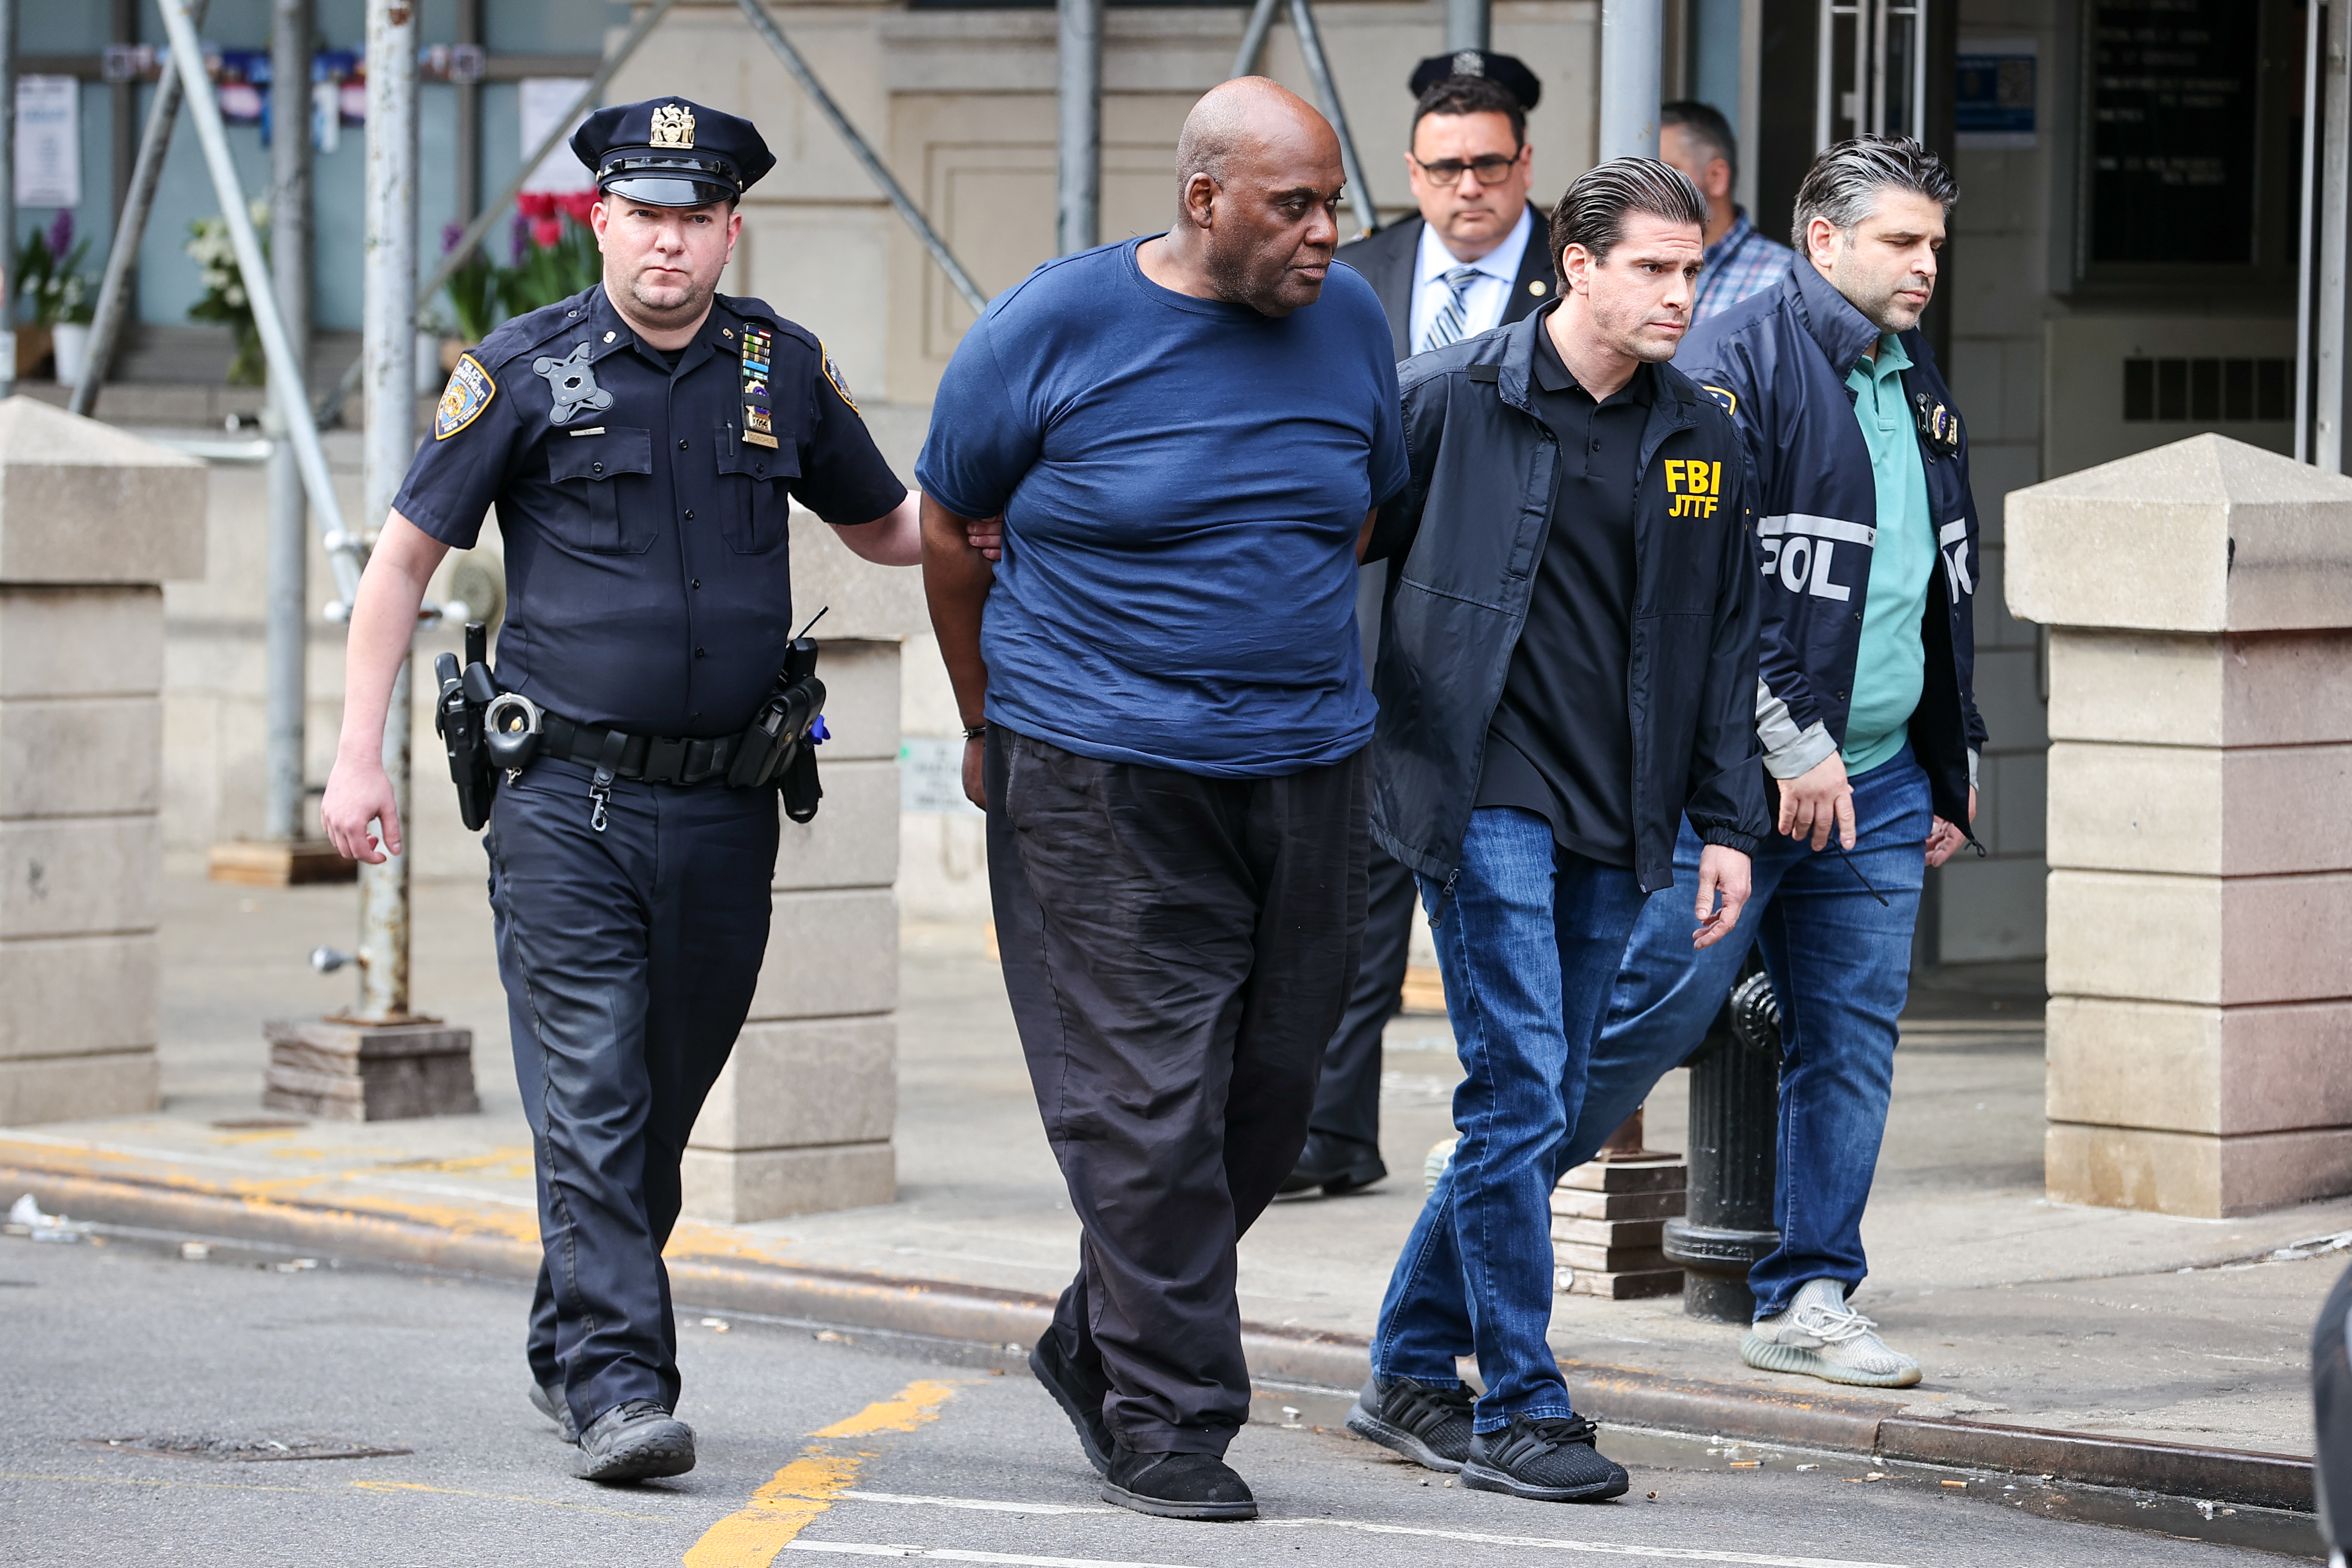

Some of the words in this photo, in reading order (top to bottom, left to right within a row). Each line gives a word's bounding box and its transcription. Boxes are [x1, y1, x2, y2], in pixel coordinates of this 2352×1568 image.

[603, 331, 617, 343] 9
[723, 328, 735, 340] 9
[463, 360, 484, 384] POLICE
[444, 419, 458, 433] NEW
[458, 404, 479, 423] YORK
[750, 434, 775, 445] DONOHUE
[1664, 459, 1721, 495] FBI
[1668, 494, 1719, 519] JTTF
[1760, 536, 1851, 602] POL
